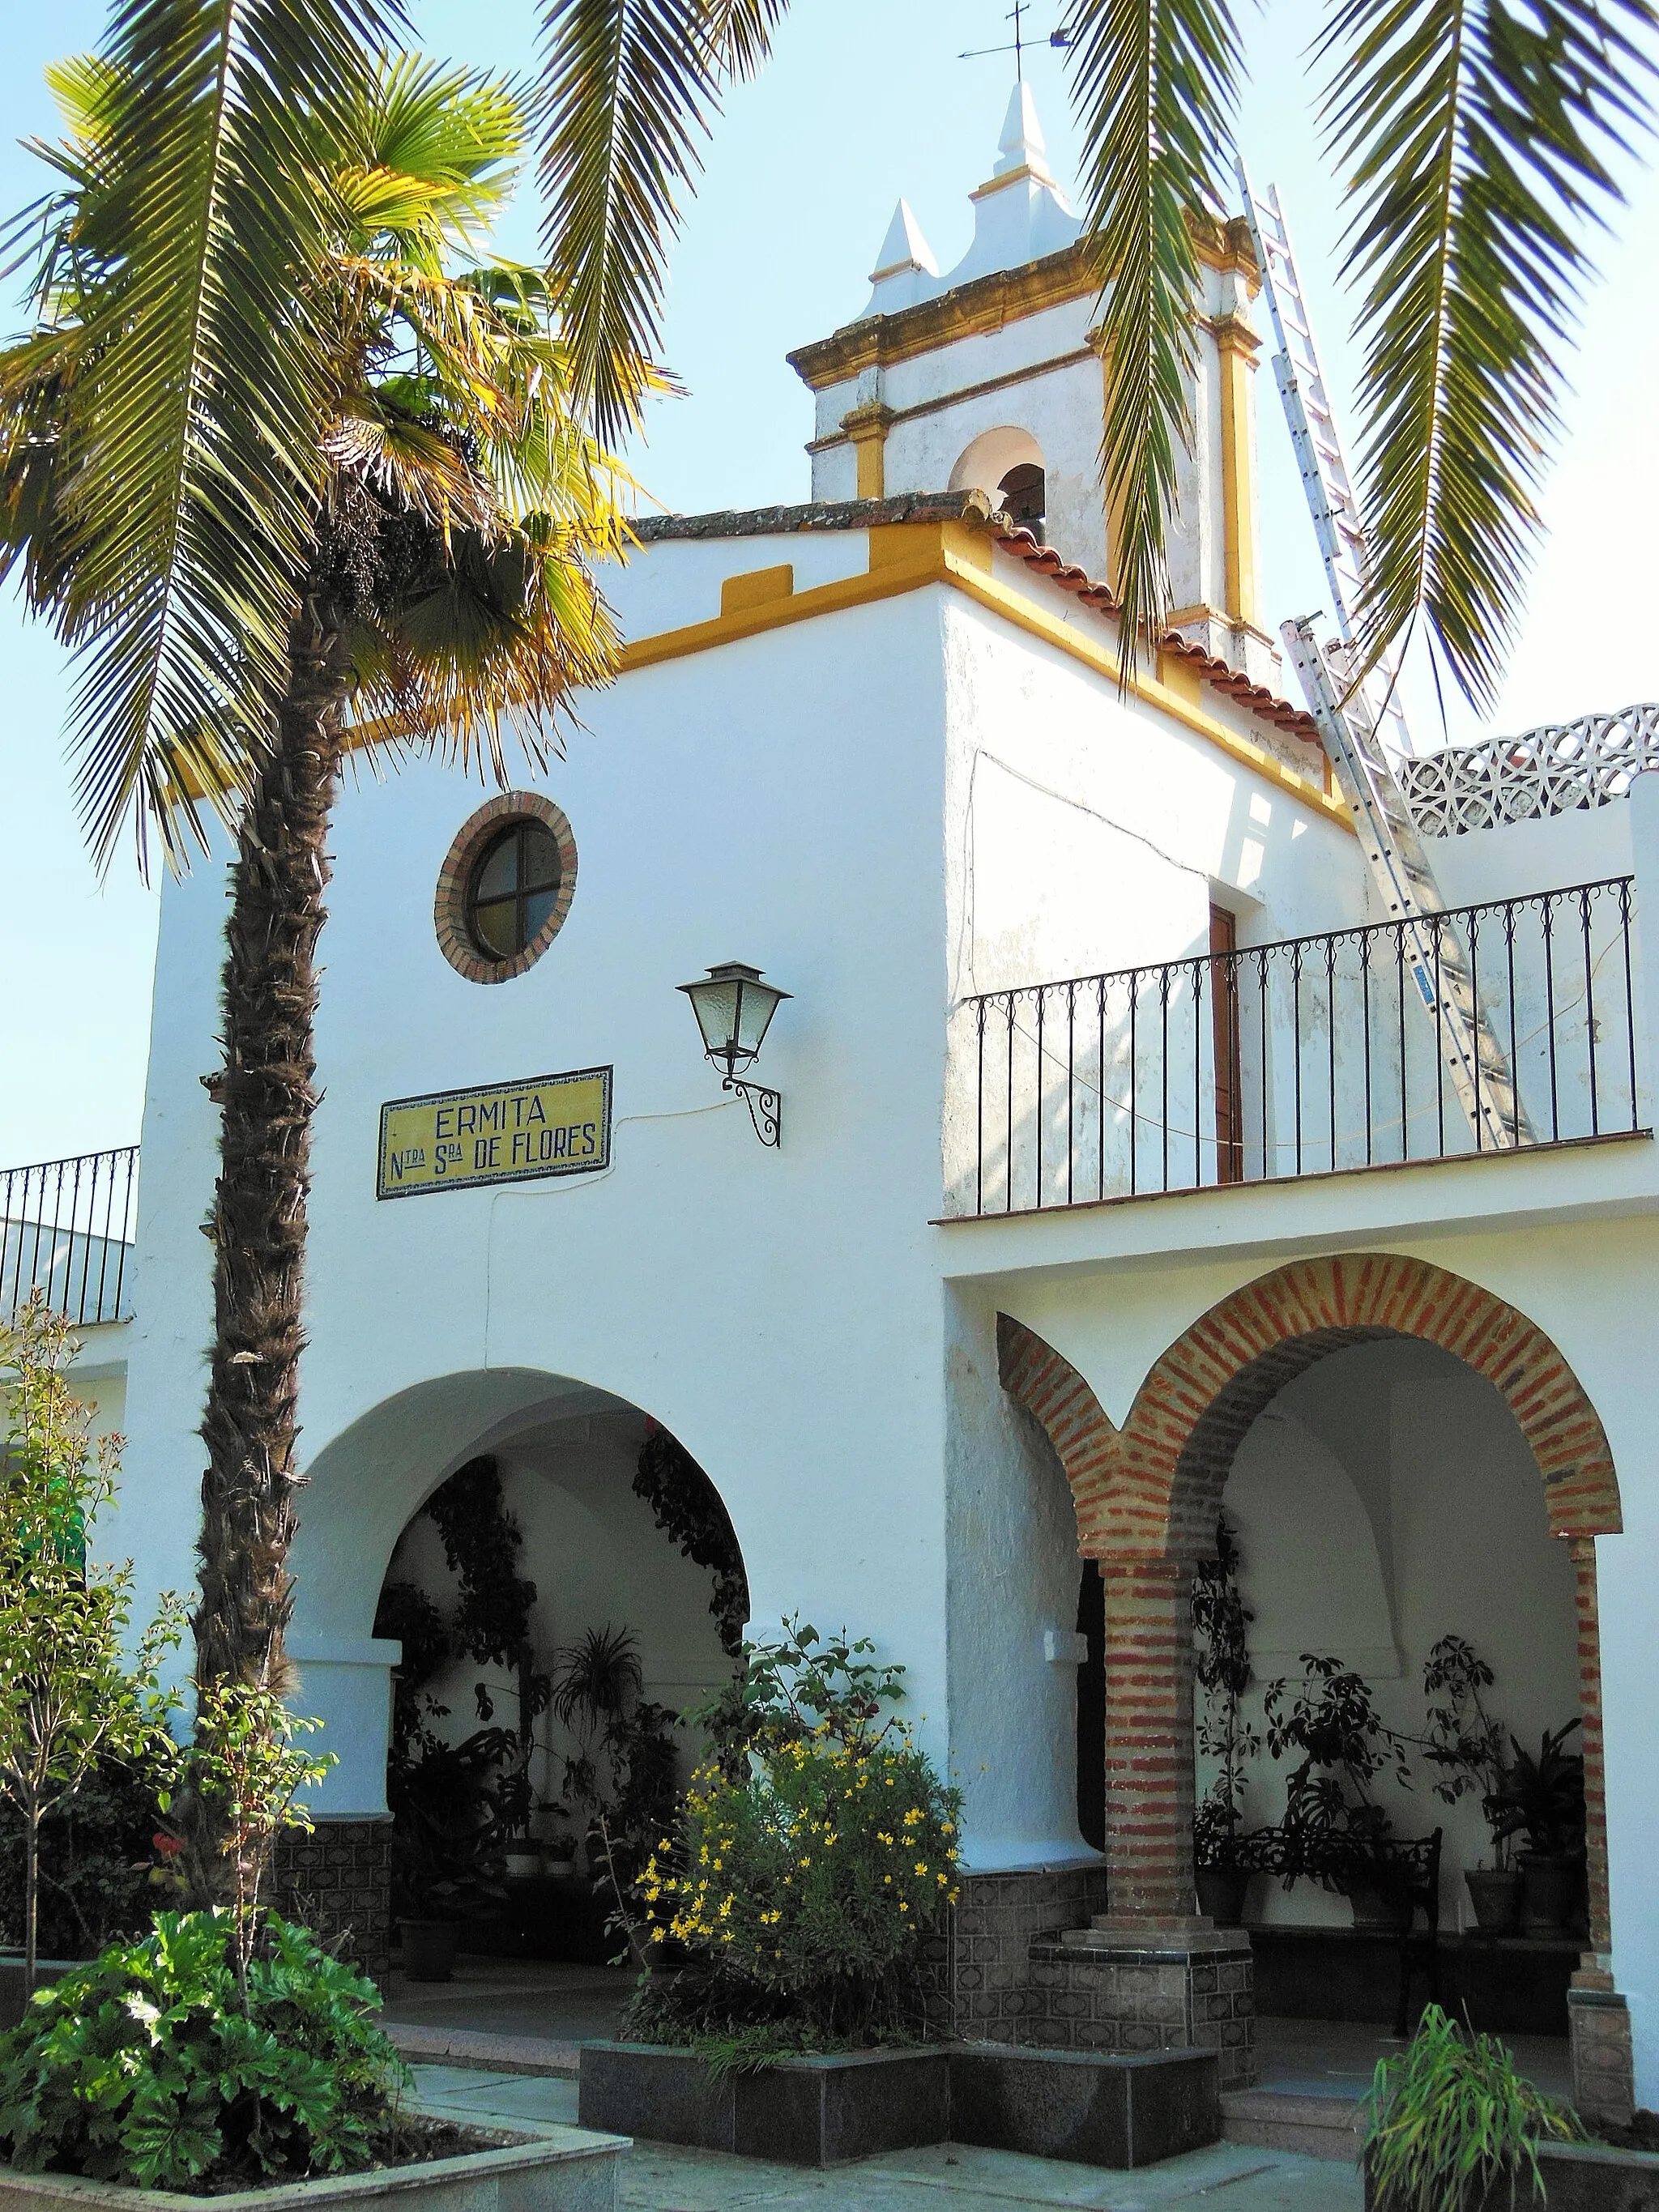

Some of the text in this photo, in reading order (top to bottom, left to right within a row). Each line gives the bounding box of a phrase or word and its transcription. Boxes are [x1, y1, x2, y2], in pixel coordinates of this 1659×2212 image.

[435, 1095, 546, 1140] ERMITA
[474, 1136, 502, 1170] DE
[511, 1123, 596, 1165] FLORES
